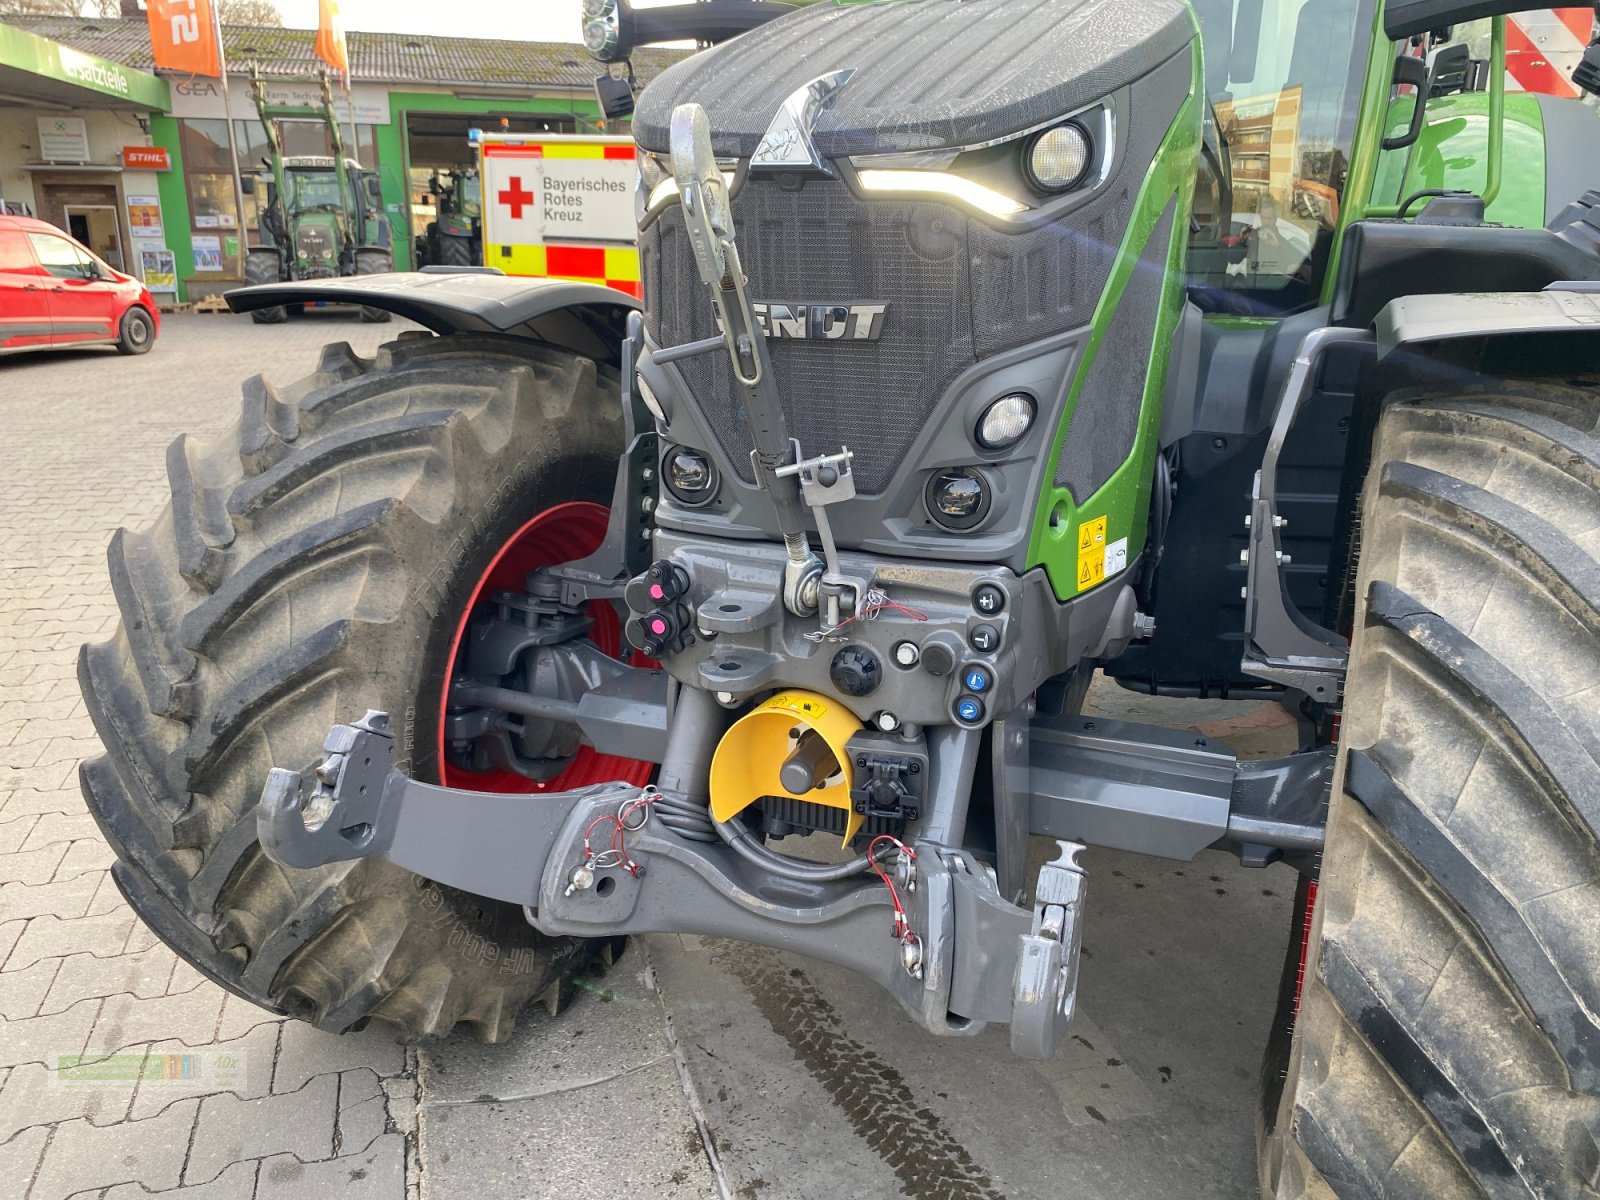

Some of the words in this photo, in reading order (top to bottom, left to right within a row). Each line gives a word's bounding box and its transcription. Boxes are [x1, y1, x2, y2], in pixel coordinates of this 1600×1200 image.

[176, 82, 217, 96] GEA
[129, 153, 163, 162] STIHL
[543, 176, 627, 193] Bayerisches
[543, 192, 583, 207] Rotes
[544, 207, 583, 222] Kreuz
